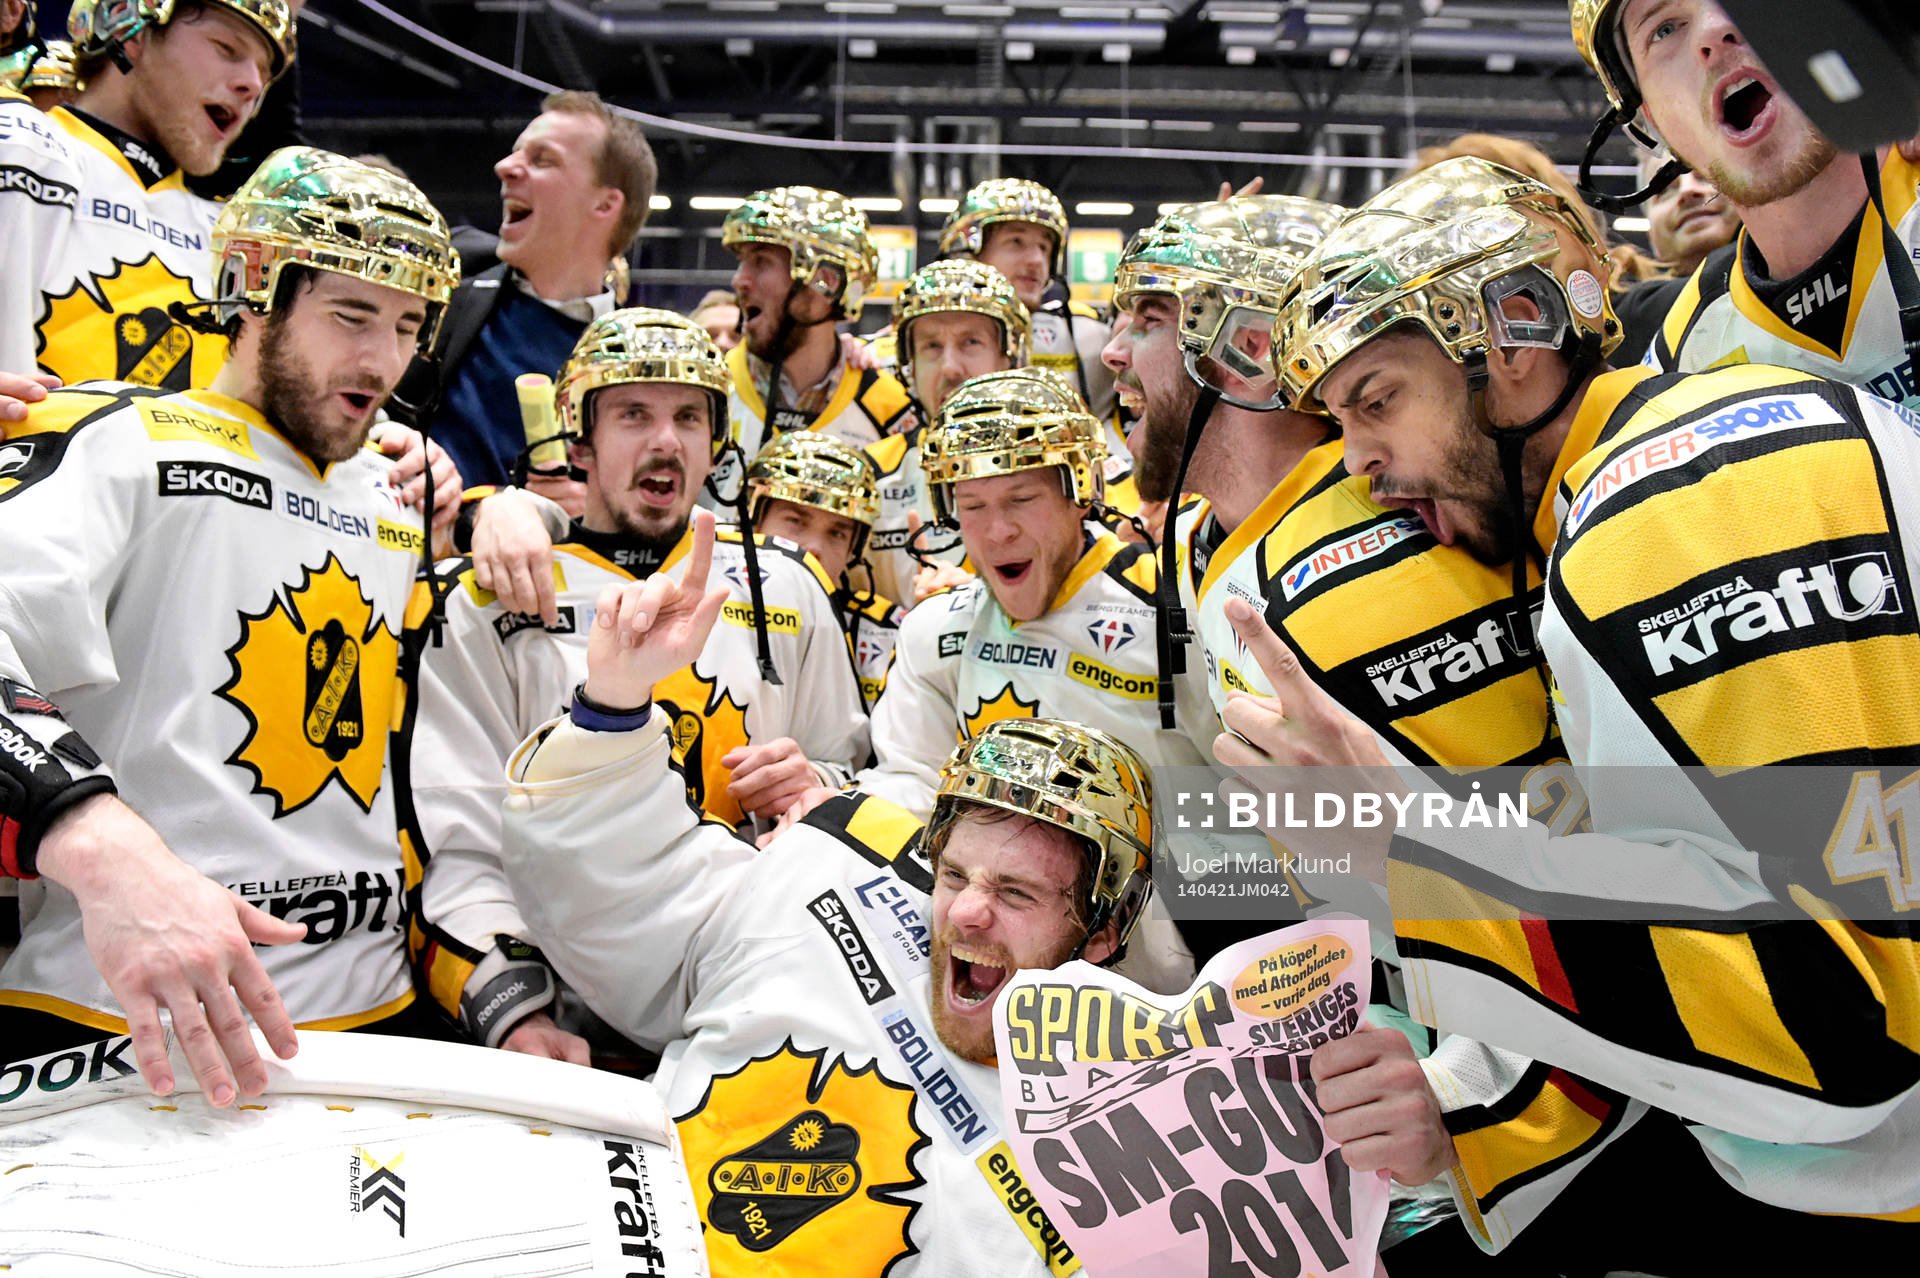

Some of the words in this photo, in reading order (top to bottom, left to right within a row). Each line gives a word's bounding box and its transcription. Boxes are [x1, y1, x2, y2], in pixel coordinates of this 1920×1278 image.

[123, 141, 163, 179] SHL
[92, 199, 202, 251] BOLIDEN
[1785, 272, 1848, 325] SHL
[1595, 399, 1805, 501] INTERSPORT
[166, 465, 269, 505] ŠKODA
[286, 491, 371, 538] BOLIDEN
[614, 550, 660, 565] SHL
[1194, 547, 1208, 573] SH
[1638, 576, 1754, 633] SKELLEFTEÅ
[1641, 563, 1858, 677] kraft
[1073, 660, 1155, 694] engcon
[1365, 632, 1458, 678] SKELLEFTEÅ
[1371, 618, 1506, 707] kraf
[0, 722, 48, 773] ebok
[336, 721, 359, 737] 1921
[813, 897, 882, 1000] ŠKODA
[892, 930, 919, 962] group
[1258, 956, 1278, 974] På
[1279, 944, 1318, 969] köpet
[1236, 979, 1269, 1000] med
[1270, 948, 1346, 992] Aftonbladet
[1273, 987, 1306, 1010] varje
[1307, 971, 1331, 992] dag
[477, 981, 528, 1026] Reebok
[1248, 981, 1359, 1046] SVERIGES
[886, 1017, 987, 1146] BOLIDEN
[1033, 1054, 1326, 1229] SM-GU
[740, 1201, 773, 1241] 1921
[988, 1152, 1075, 1267] engcon
